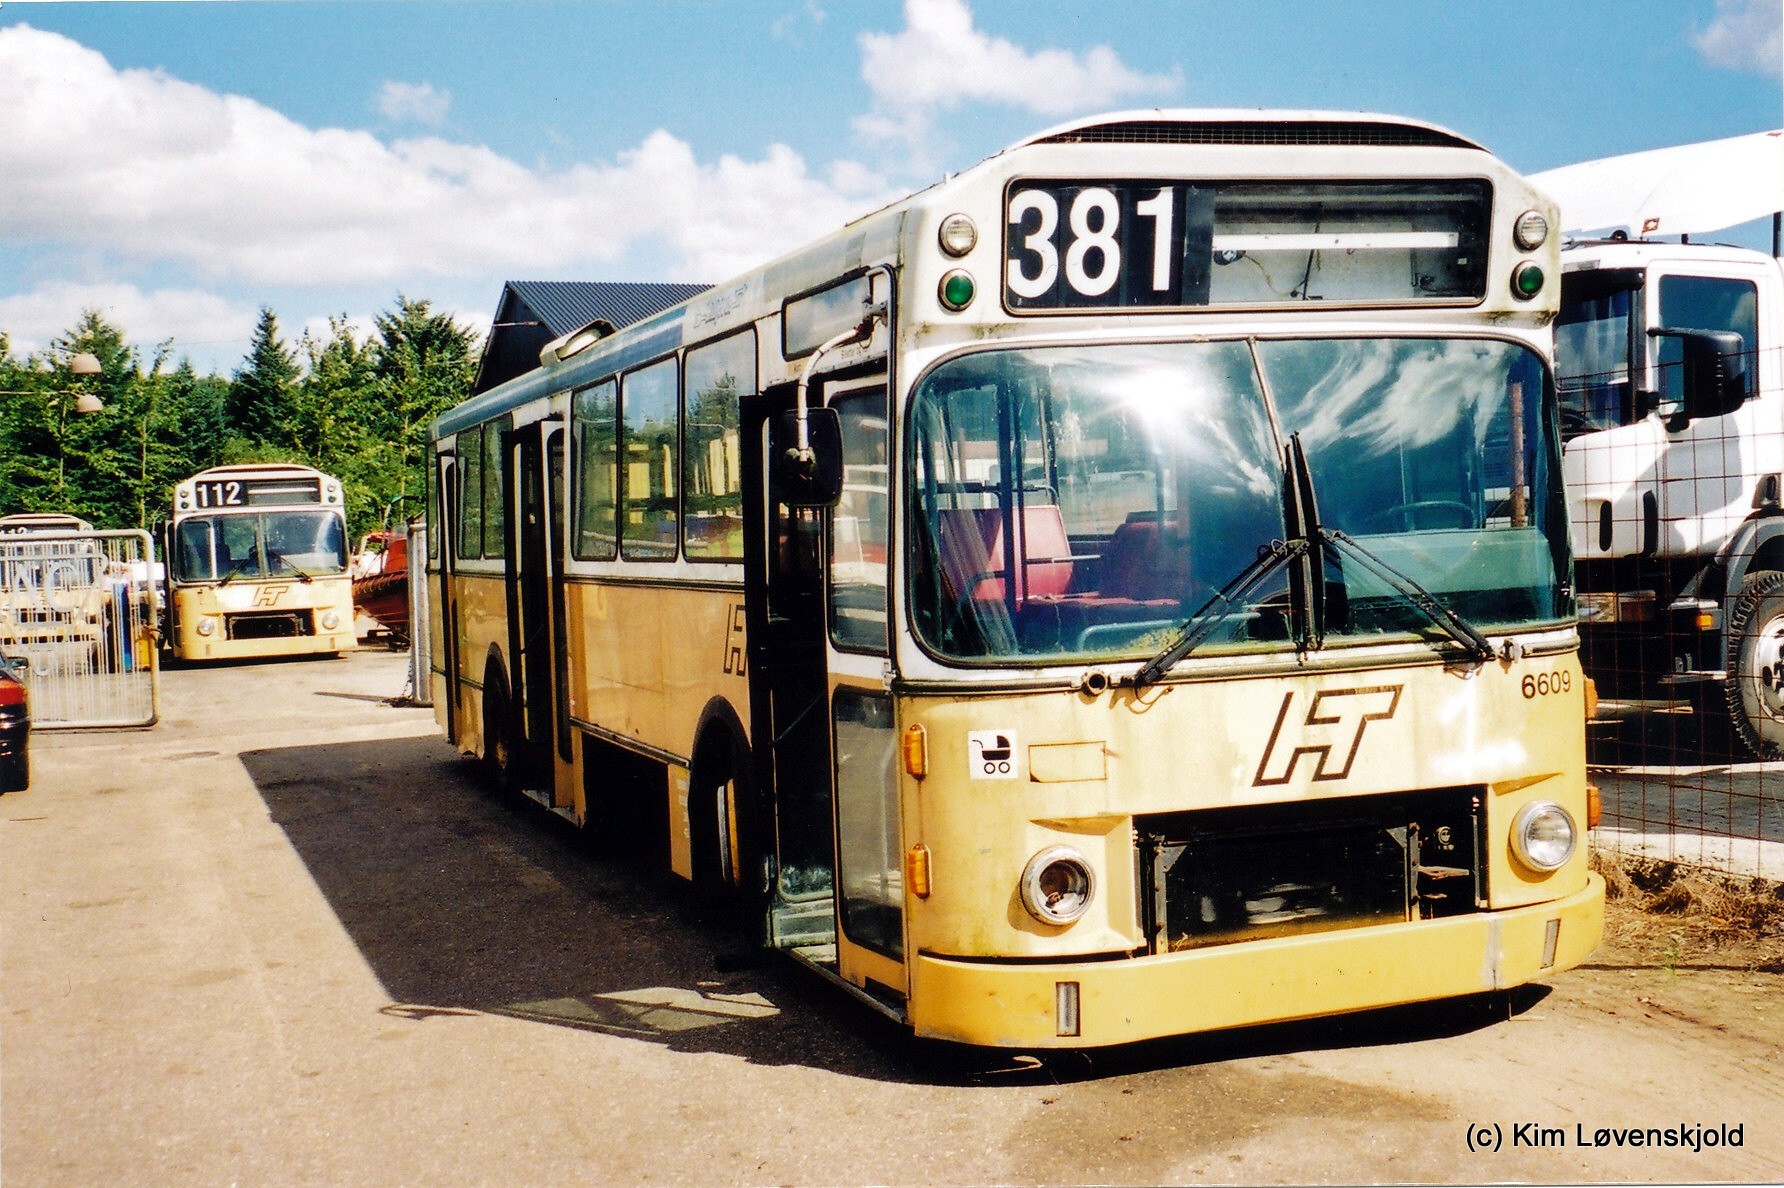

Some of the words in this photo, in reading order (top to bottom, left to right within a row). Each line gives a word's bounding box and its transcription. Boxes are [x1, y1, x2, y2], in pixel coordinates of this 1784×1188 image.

[1007, 187, 1174, 298] 381
[197, 482, 242, 507] 112
[1521, 669, 1571, 699] 6609
